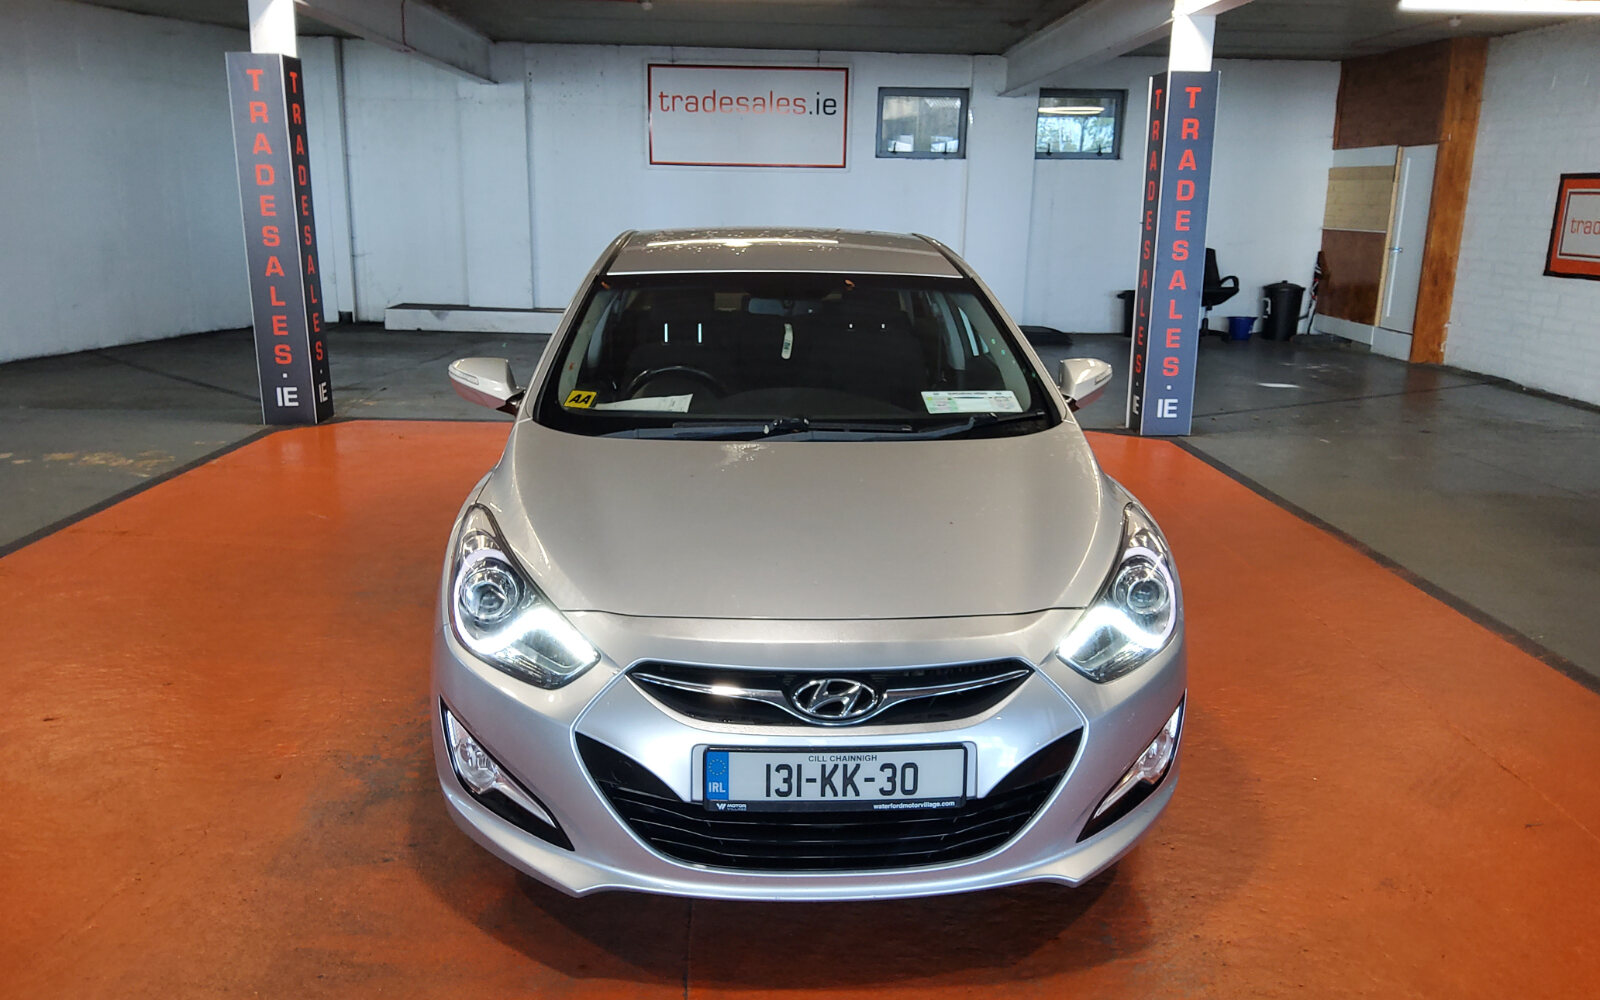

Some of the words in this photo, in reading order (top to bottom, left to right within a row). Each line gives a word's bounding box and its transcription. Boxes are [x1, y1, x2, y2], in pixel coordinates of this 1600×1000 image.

[658, 89, 837, 116] tradesales.ie
[569, 394, 592, 405] AA
[708, 782, 726, 793] IRL
[766, 762, 919, 798] 131-KK-30
